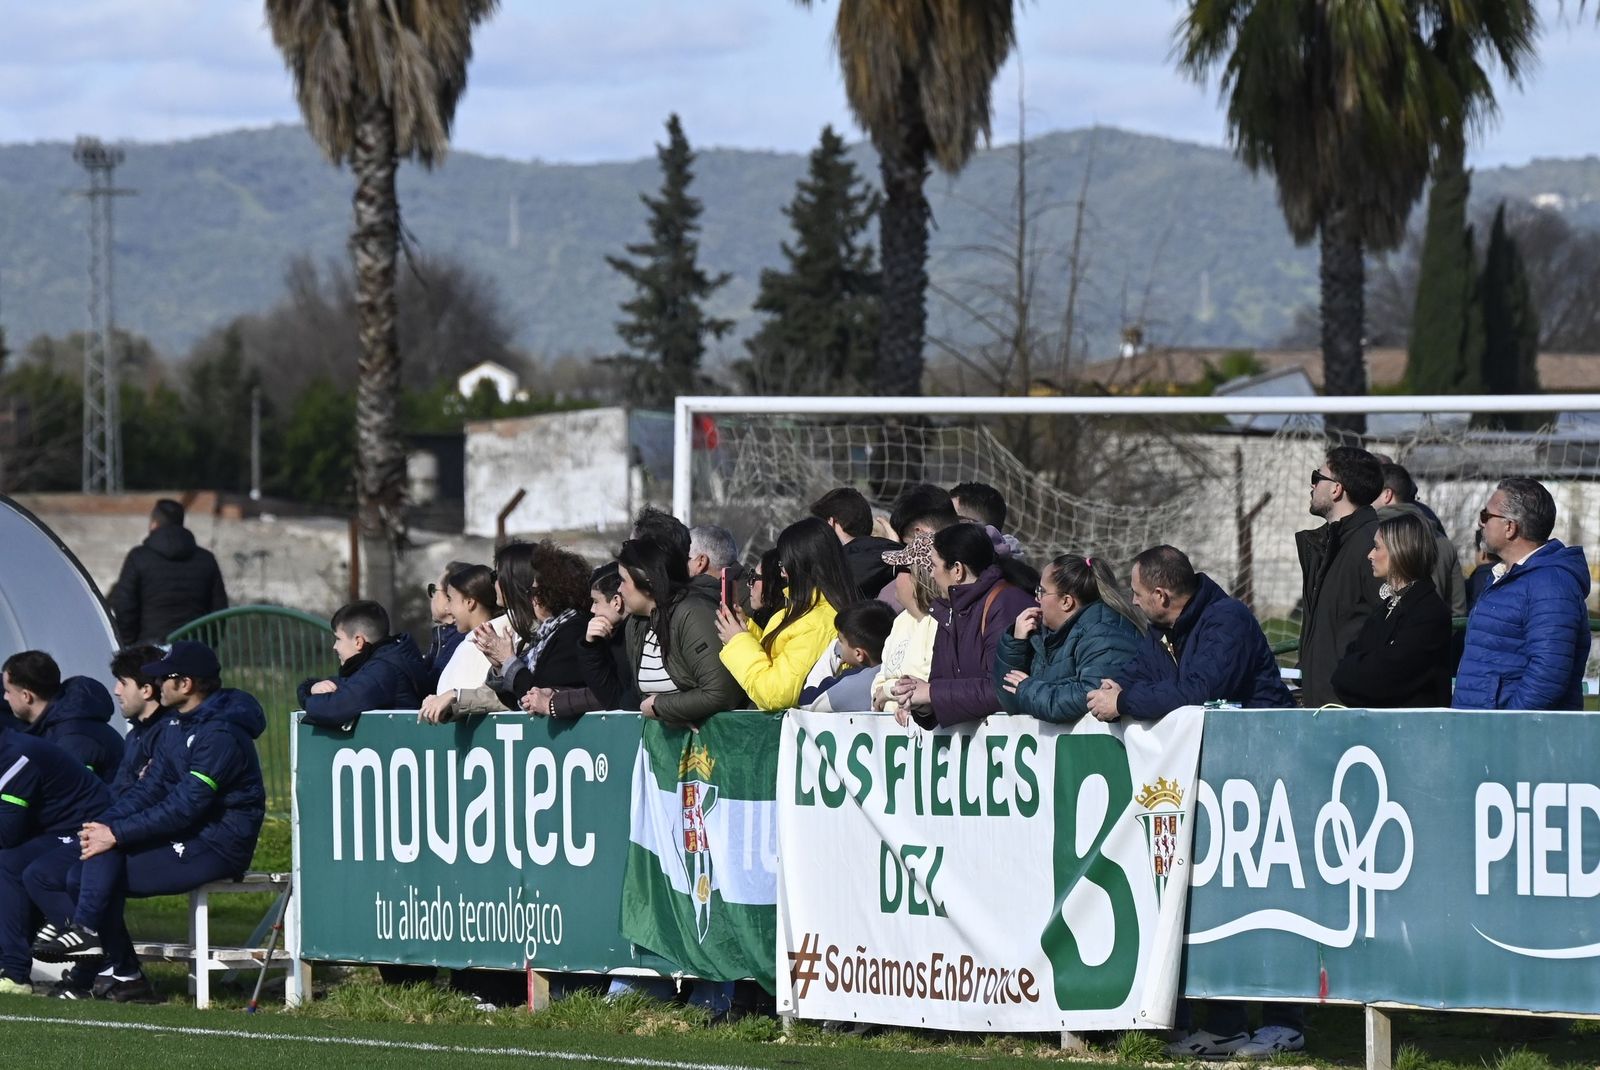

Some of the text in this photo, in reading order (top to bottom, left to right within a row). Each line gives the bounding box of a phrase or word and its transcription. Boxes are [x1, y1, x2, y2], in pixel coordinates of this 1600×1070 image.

[795, 727, 1040, 818] LOS FIELES
[880, 840, 948, 918] DEL
[1041, 734, 1140, 1011] B
[376, 886, 562, 960] tu aliado tecnológico
[787, 933, 1040, 1004] #SoñamosEnBronce
